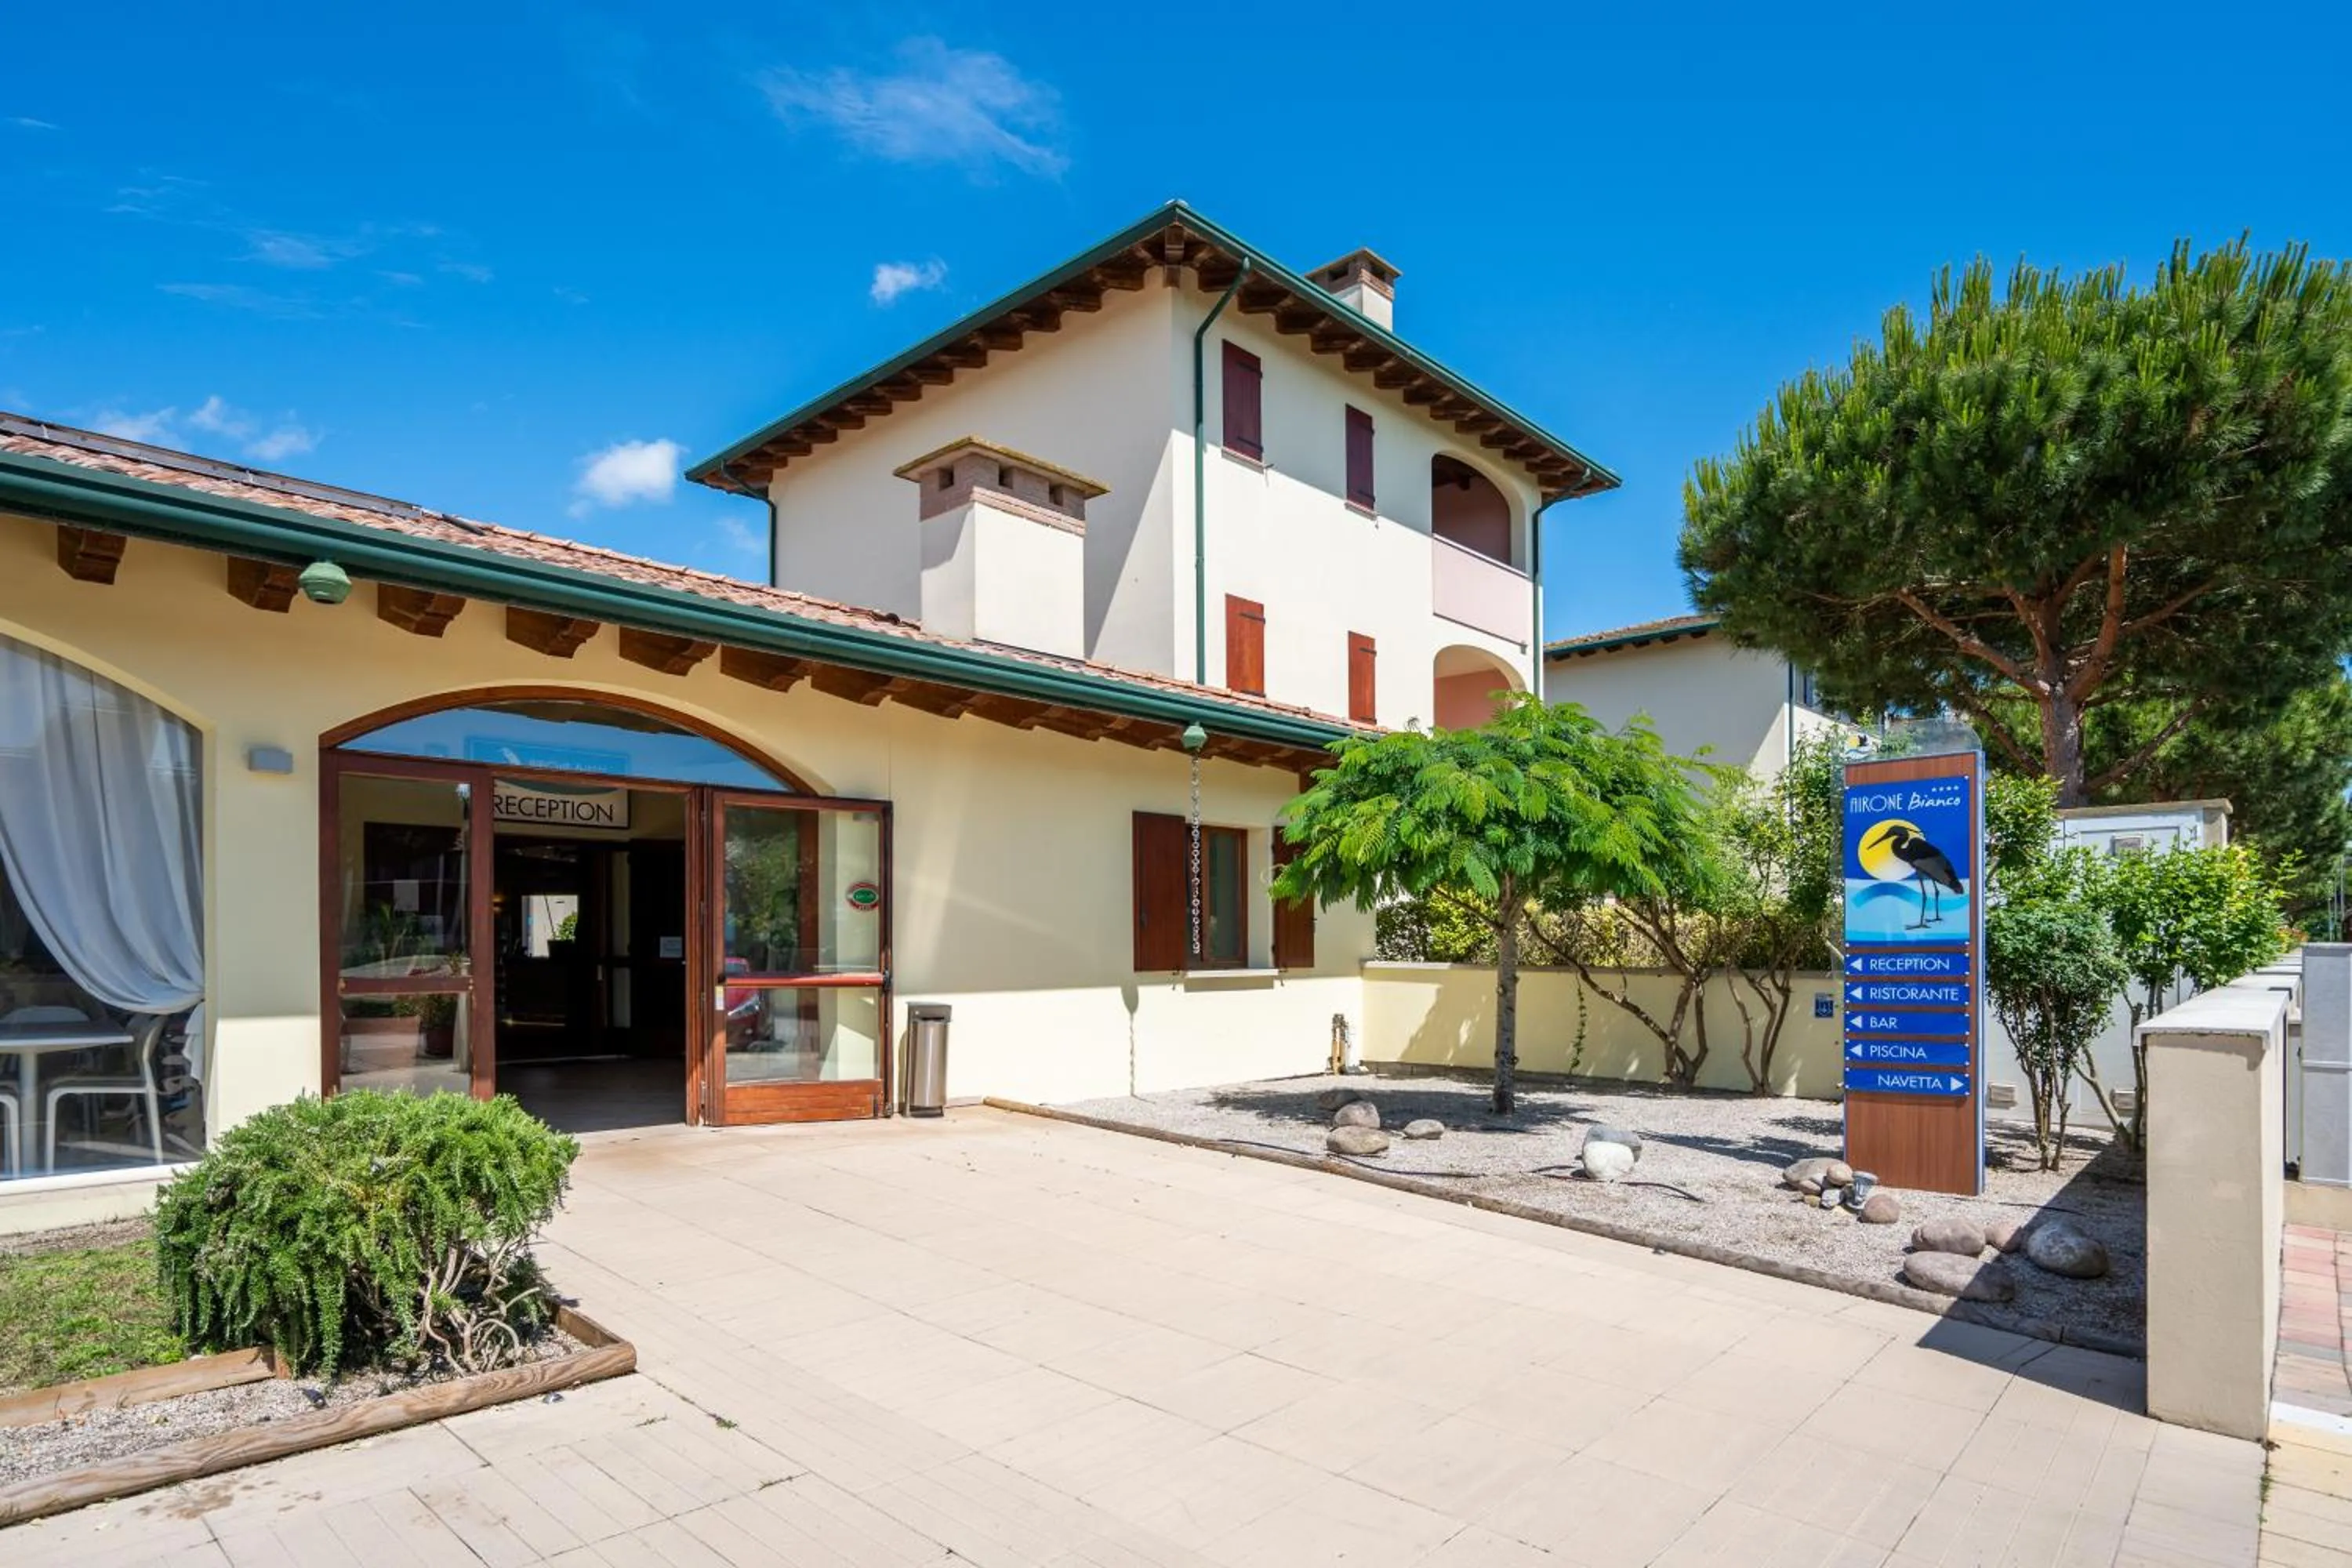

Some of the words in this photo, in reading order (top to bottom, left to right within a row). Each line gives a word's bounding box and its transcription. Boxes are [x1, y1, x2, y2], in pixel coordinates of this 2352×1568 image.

[492, 794, 614, 822] RECEPTION
[1849, 793, 1904, 813] AIRONE
[1907, 791, 1961, 811] Bianco
[1869, 957, 1950, 971] RECEPTION
[1869, 986, 1959, 1001] RISTORANTE
[1869, 1016, 1898, 1029] BAR
[1869, 1044, 1928, 1058] PISCINA
[1877, 1074, 1943, 1090] NAVETTA
